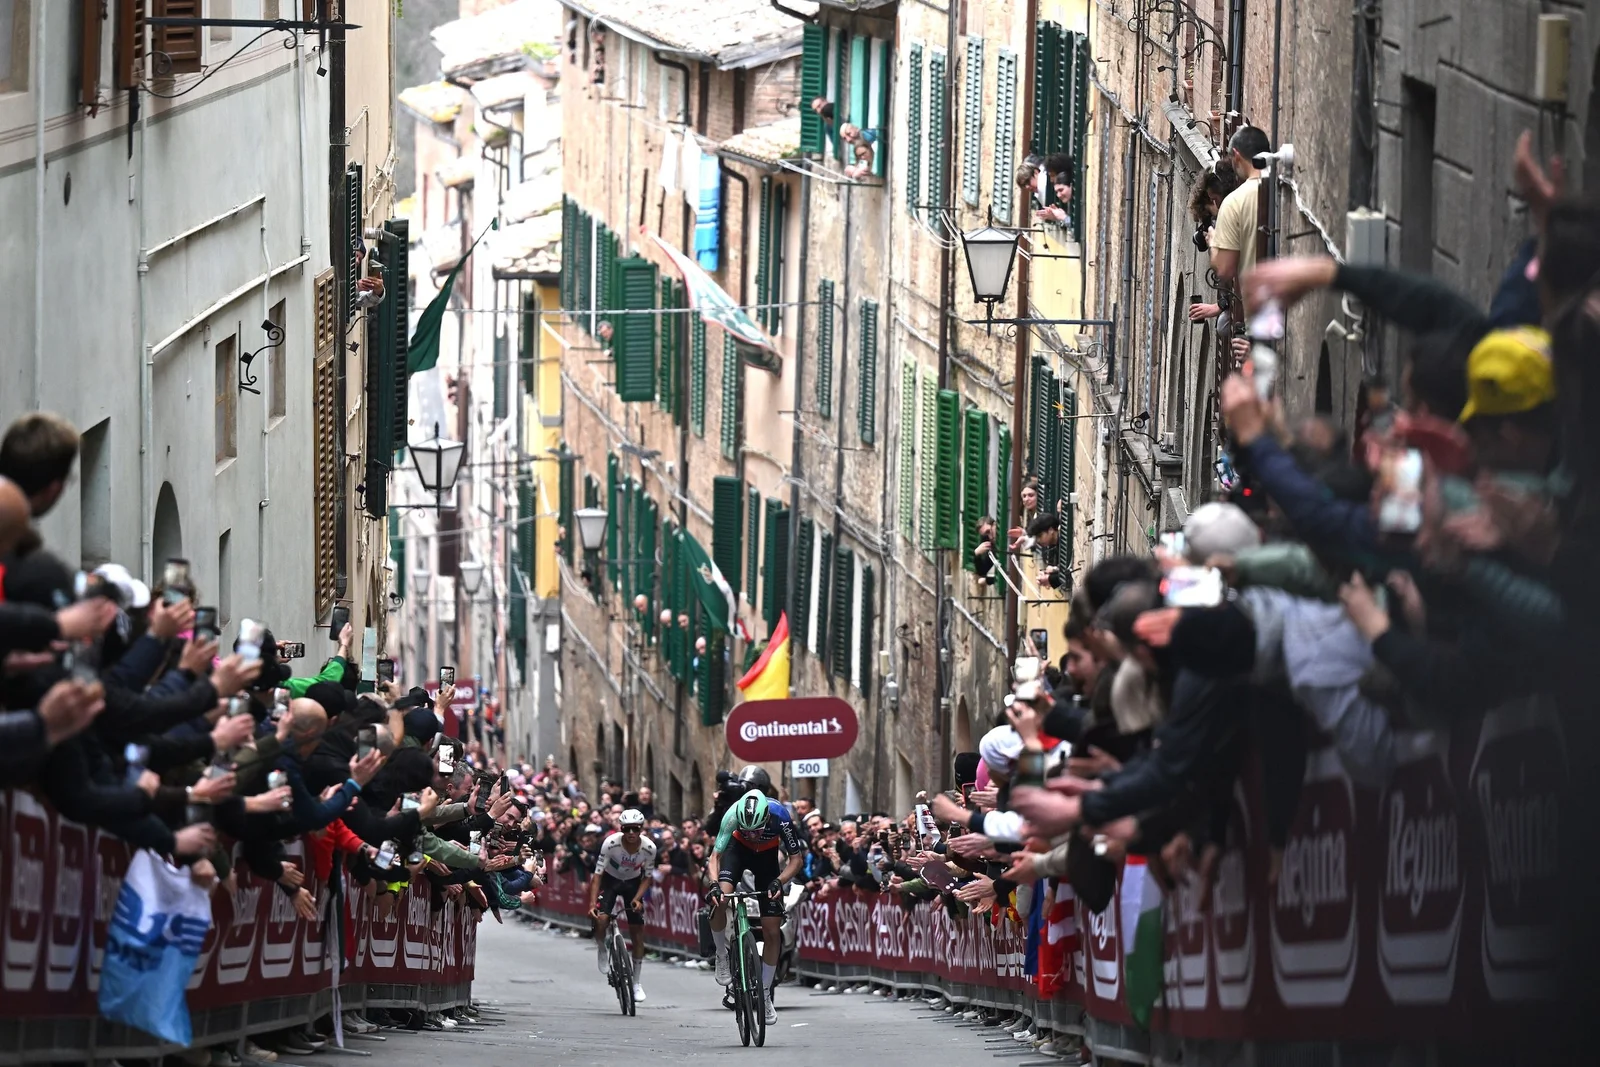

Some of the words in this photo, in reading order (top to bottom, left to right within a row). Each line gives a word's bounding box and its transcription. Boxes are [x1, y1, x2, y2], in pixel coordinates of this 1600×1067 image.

[740, 718, 828, 742] Continental
[797, 762, 821, 775] 500
[780, 821, 798, 849] Adecco
[1385, 785, 1459, 918] Regina
